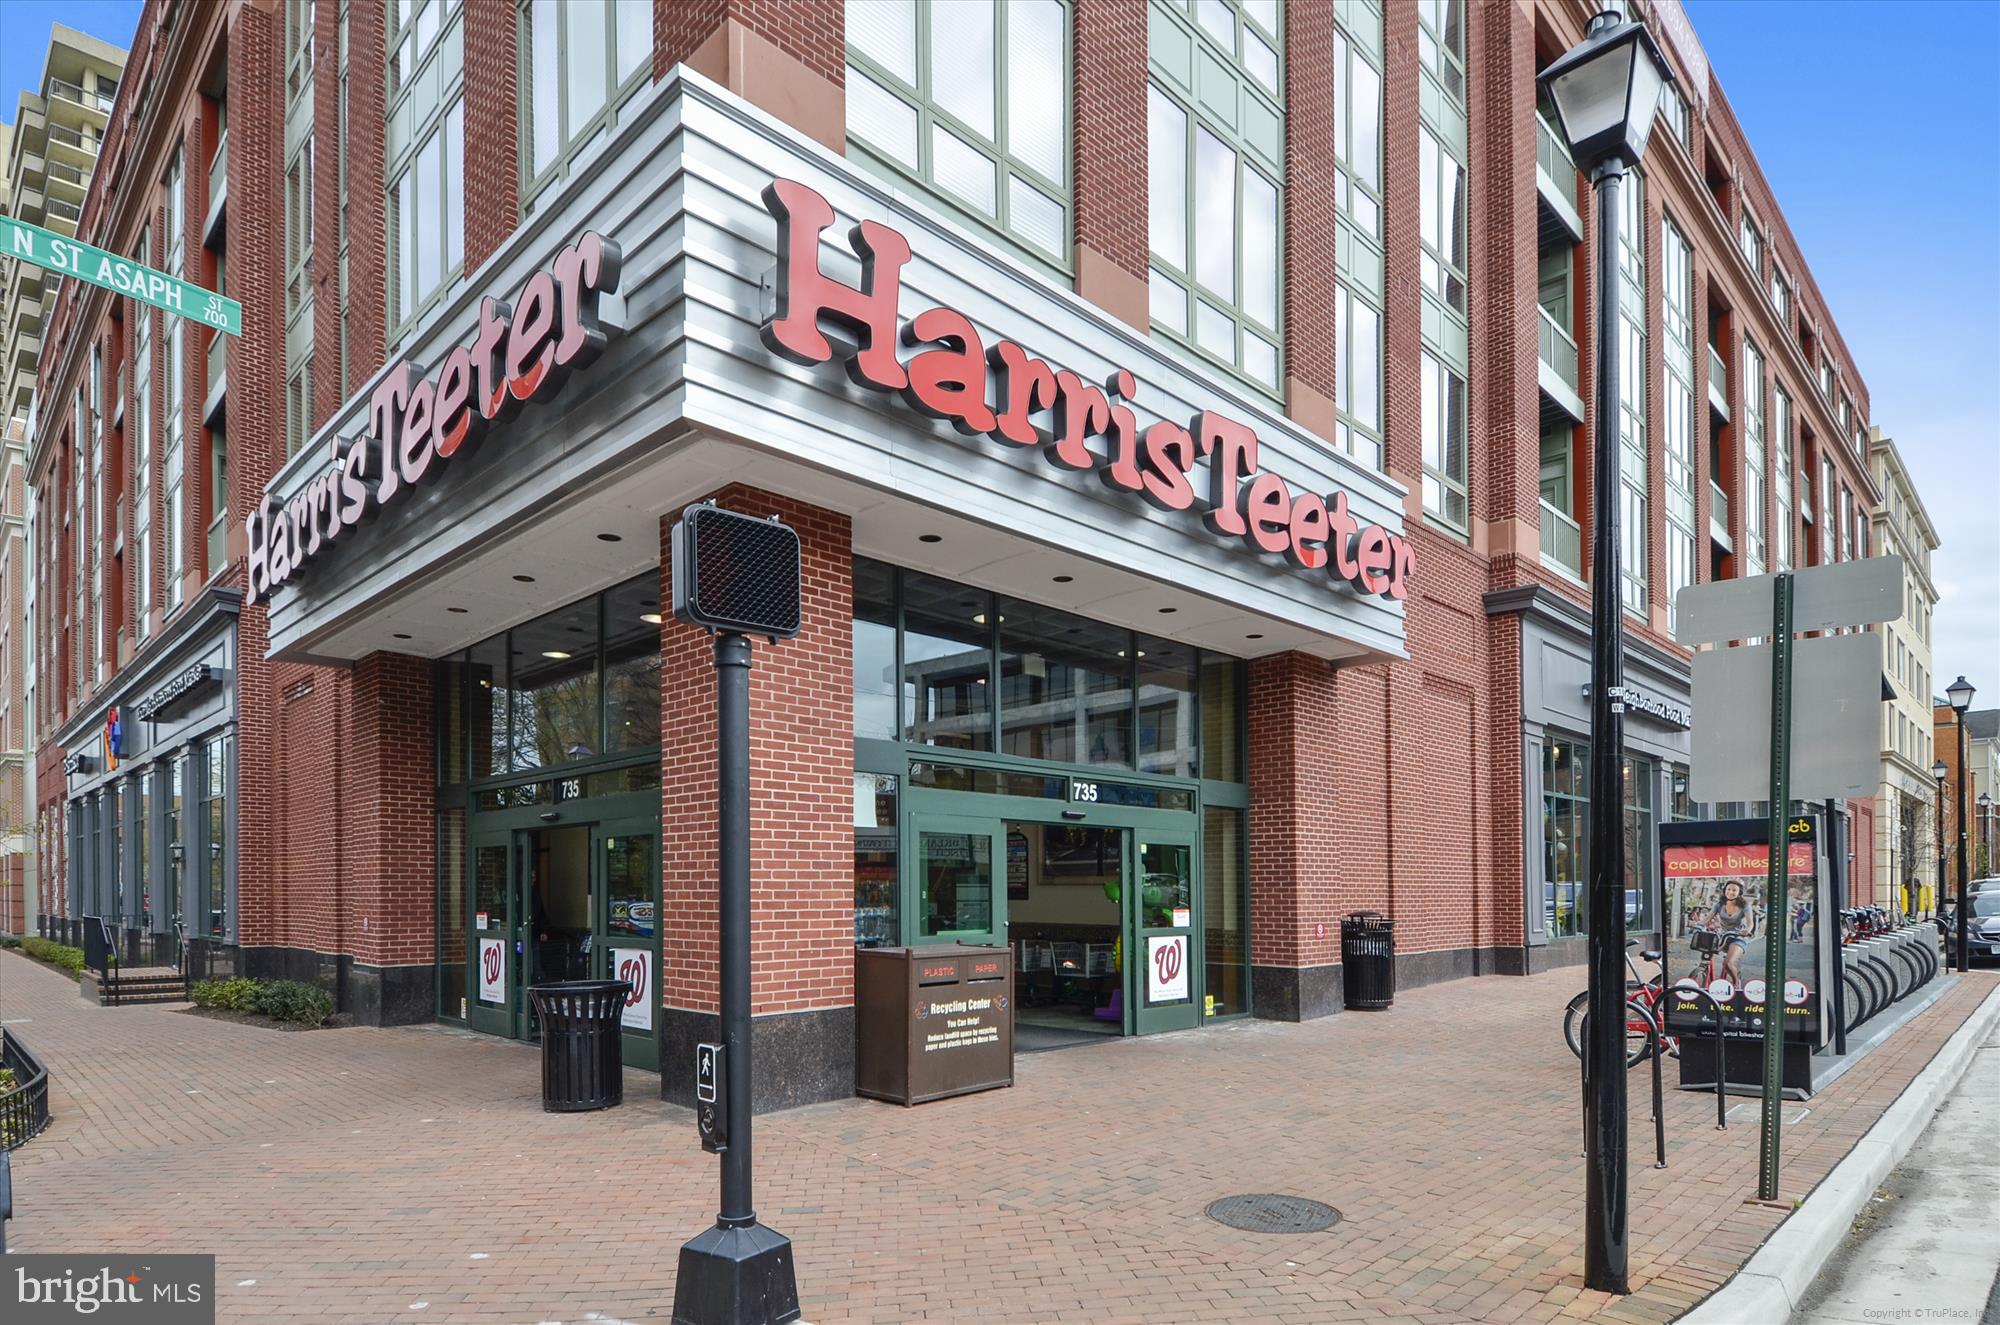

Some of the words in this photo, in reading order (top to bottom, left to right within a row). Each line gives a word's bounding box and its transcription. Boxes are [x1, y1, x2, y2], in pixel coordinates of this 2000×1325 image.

[13, 226, 33, 257] N
[50, 239, 83, 272] ST
[96, 257, 182, 309] ASAPH
[208, 295, 224, 310] ST
[203, 307, 228, 327] 700
[761, 177, 1194, 511] Harris
[1189, 409, 1416, 600] Teeter
[246, 433, 374, 606] Harris
[369, 230, 618, 506] Teeter
[1624, 689, 1665, 718] eighborhood
[562, 780, 579, 799] 735
[1073, 782, 1098, 801] 735
[1668, 857, 1723, 872] capital
[1728, 855, 1806, 869] bikesre
[483, 942, 501, 986] W
[975, 964, 997, 972] PAPER
[1155, 939, 1182, 985] W
[924, 968, 954, 976] PLASTIC
[931, 1001, 966, 1014] Recycling
[968, 999, 990, 1010] Center
[1676, 1001, 1699, 1011] join.
[1710, 1002, 1734, 1012] tke.
[1744, 1002, 1765, 1013] ride
[1783, 1007, 1811, 1015] turn.
[947, 1019, 957, 1028] You
[957, 1018, 967, 1027] Can
[967, 1017, 979, 1025] Help!
[925, 1043, 938, 1052] paper
[939, 1041, 947, 1049] and
